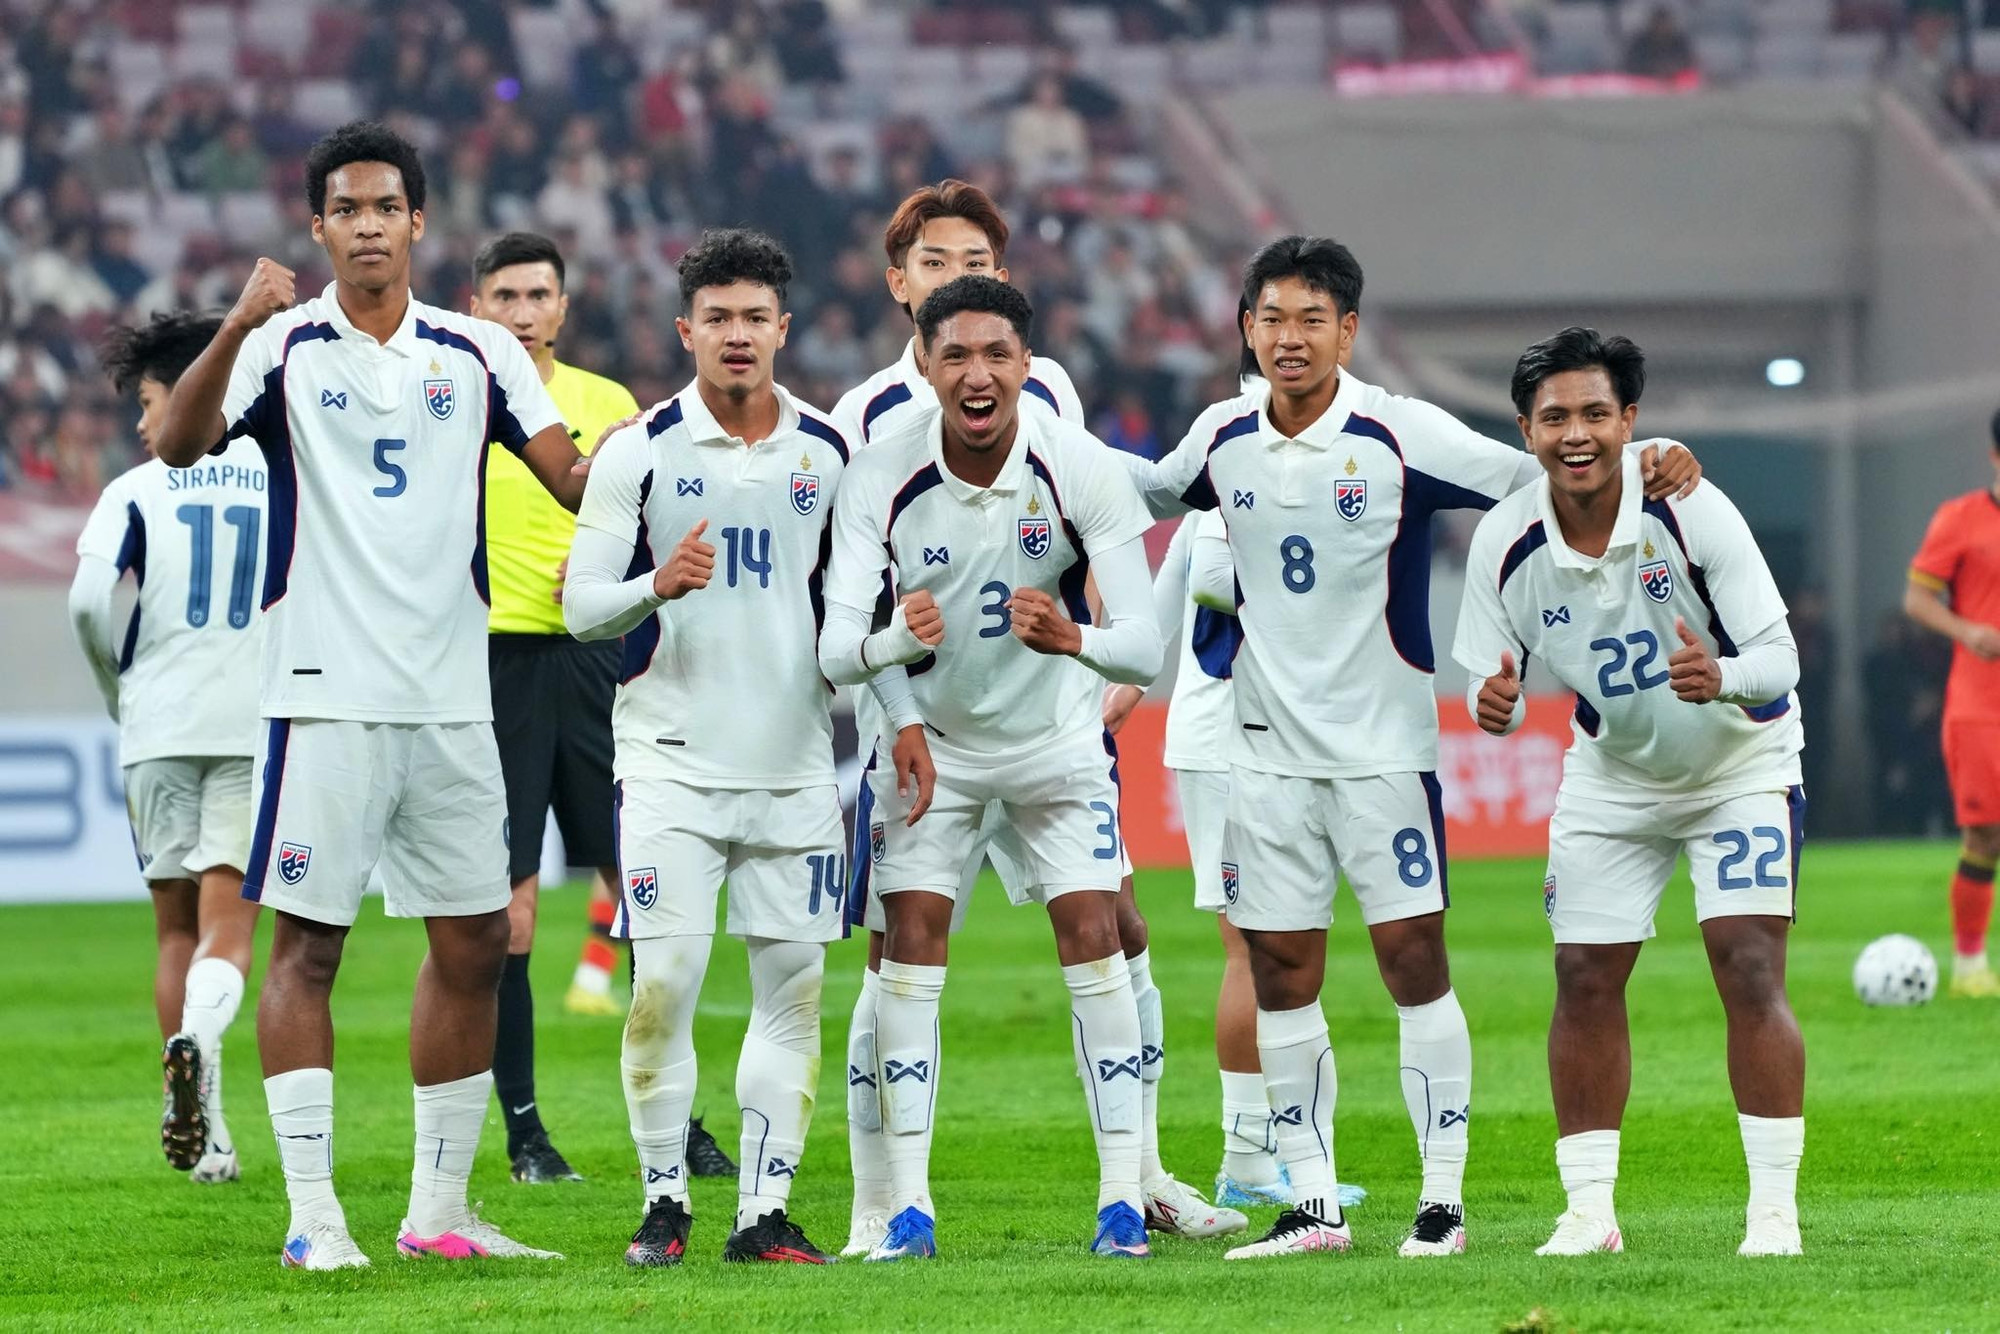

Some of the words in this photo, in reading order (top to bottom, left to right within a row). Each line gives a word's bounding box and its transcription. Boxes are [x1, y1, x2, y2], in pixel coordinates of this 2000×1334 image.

[168, 465, 265, 491] SIRAPHO
[373, 438, 407, 497] 5
[176, 504, 261, 630] 11
[721, 526, 772, 589] 14
[1280, 534, 1315, 594] 8
[979, 580, 1012, 638] 3
[1590, 629, 1670, 697] 22
[1090, 801, 1118, 859] 3
[1392, 827, 1433, 888] 8
[1713, 826, 1788, 889] 22
[806, 854, 845, 915] 14
